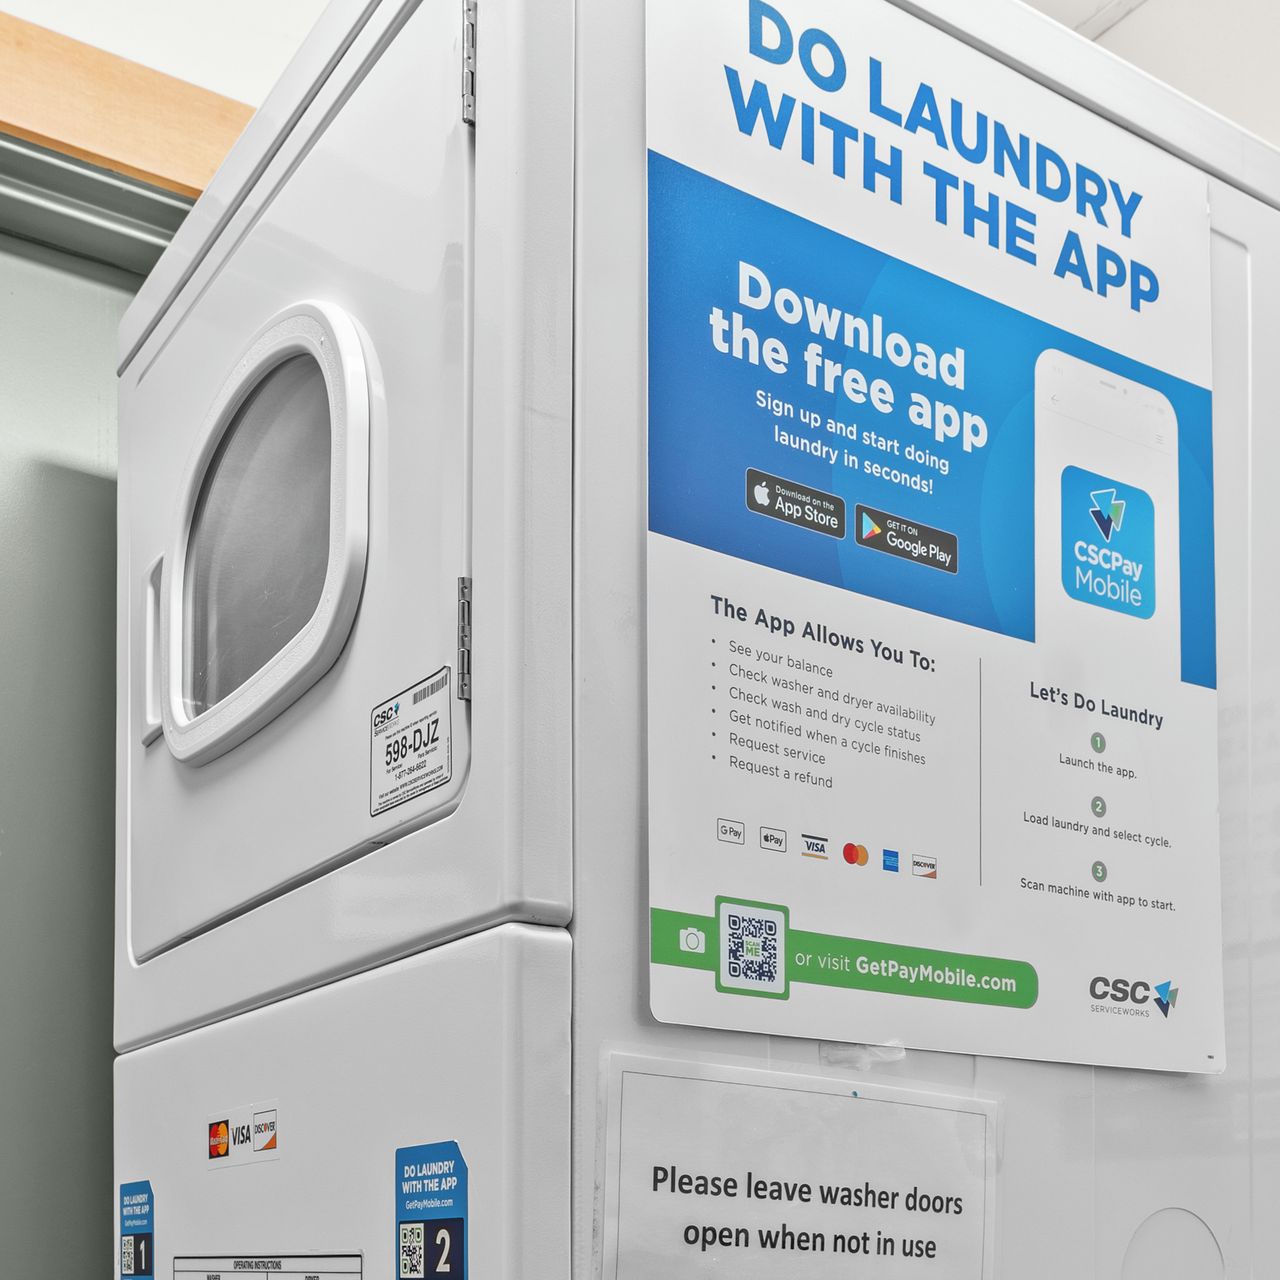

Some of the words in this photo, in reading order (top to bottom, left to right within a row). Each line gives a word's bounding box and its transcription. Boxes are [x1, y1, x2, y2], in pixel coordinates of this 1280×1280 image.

[749, 0, 846, 92] DO
[869, 56, 1143, 238] LAUNDRY
[724, 64, 902, 205] WITH
[923, 161, 1036, 266] THE
[1054, 230, 1159, 312] APP
[739, 261, 965, 390] Download
[710, 306, 788, 374] the
[804, 343, 894, 413] free
[909, 392, 988, 453] app
[756, 390, 794, 418] Sign
[800, 411, 821, 428] up
[827, 418, 856, 440] and
[863, 430, 899, 455] start
[905, 445, 949, 474] doing
[775, 425, 838, 465] laundry
[844, 450, 858, 469] in
[864, 460, 933, 494] seconds!
[775, 496, 802, 519] App
[805, 506, 838, 528] Store
[887, 532, 927, 557] Google
[929, 544, 951, 566] Play
[1074, 540, 1142, 581] CSCPay
[1076, 566, 1142, 606] Mobile
[711, 595, 747, 621] The
[755, 609, 795, 637] App
[802, 621, 864, 653] Allows
[871, 639, 904, 664] You
[910, 650, 935, 672] To:
[729, 640, 751, 656] See
[756, 649, 783, 665] your
[788, 655, 833, 677] balance
[373, 707, 393, 727] CSC
[1075, 693, 1095, 712] Do
[1102, 699, 1163, 730] Laundry
[385, 718, 439, 766] 598-DJZ
[730, 733, 779, 754] Request
[784, 745, 825, 764] service
[1096, 737, 1100, 748] 1
[730, 756, 779, 778] Request
[784, 769, 790, 779] a
[795, 772, 832, 788] refund
[1060, 753, 1094, 770] Launch
[1098, 762, 1113, 773] the
[1117, 767, 1136, 780] app.
[1096, 801, 1102, 812] 2
[1024, 811, 1048, 826] Load
[1052, 817, 1089, 835] laundry
[1092, 826, 1110, 837] and
[1113, 830, 1142, 843] select
[1145, 836, 1171, 848] cycle.
[806, 840, 825, 853] VISA
[1096, 866, 1102, 877] 3
[1021, 878, 1044, 891] Scan
[1048, 884, 1089, 898] machine
[1093, 891, 1113, 902] with
[1117, 895, 1135, 906] app
[1138, 897, 1148, 907] to
[1151, 899, 1175, 911] start.
[795, 952, 811, 966] or
[818, 955, 850, 972] visit
[856, 956, 1016, 992] GetPayMobile.com
[1090, 977, 1150, 1004] CSC
[1091, 1005, 1150, 1017] SERVICEWORKS
[231, 1125, 251, 1145] VISA
[255, 1121, 275, 1134] DISCOVER
[404, 1165, 416, 1177] DO
[417, 1160, 455, 1176] LAUNDRY
[402, 1180, 422, 1194] WITH
[424, 1179, 439, 1192] THE
[441, 1177, 457, 1190] APP
[652, 1166, 738, 1197] Please
[746, 1172, 812, 1203] leave
[820, 1182, 899, 1210] washer
[905, 1187, 963, 1215] doors
[406, 1198, 453, 1210] GetPayMobile.com
[140, 1240, 145, 1270] 1
[436, 1228, 450, 1272] 2
[683, 1224, 749, 1251] open
[758, 1224, 825, 1252] when
[833, 1231, 869, 1254] not
[876, 1231, 895, 1256] in
[902, 1238, 936, 1258] use
[234, 1261, 254, 1270] OPERATING
[254, 1261, 281, 1270] INSTRUCTIONS
